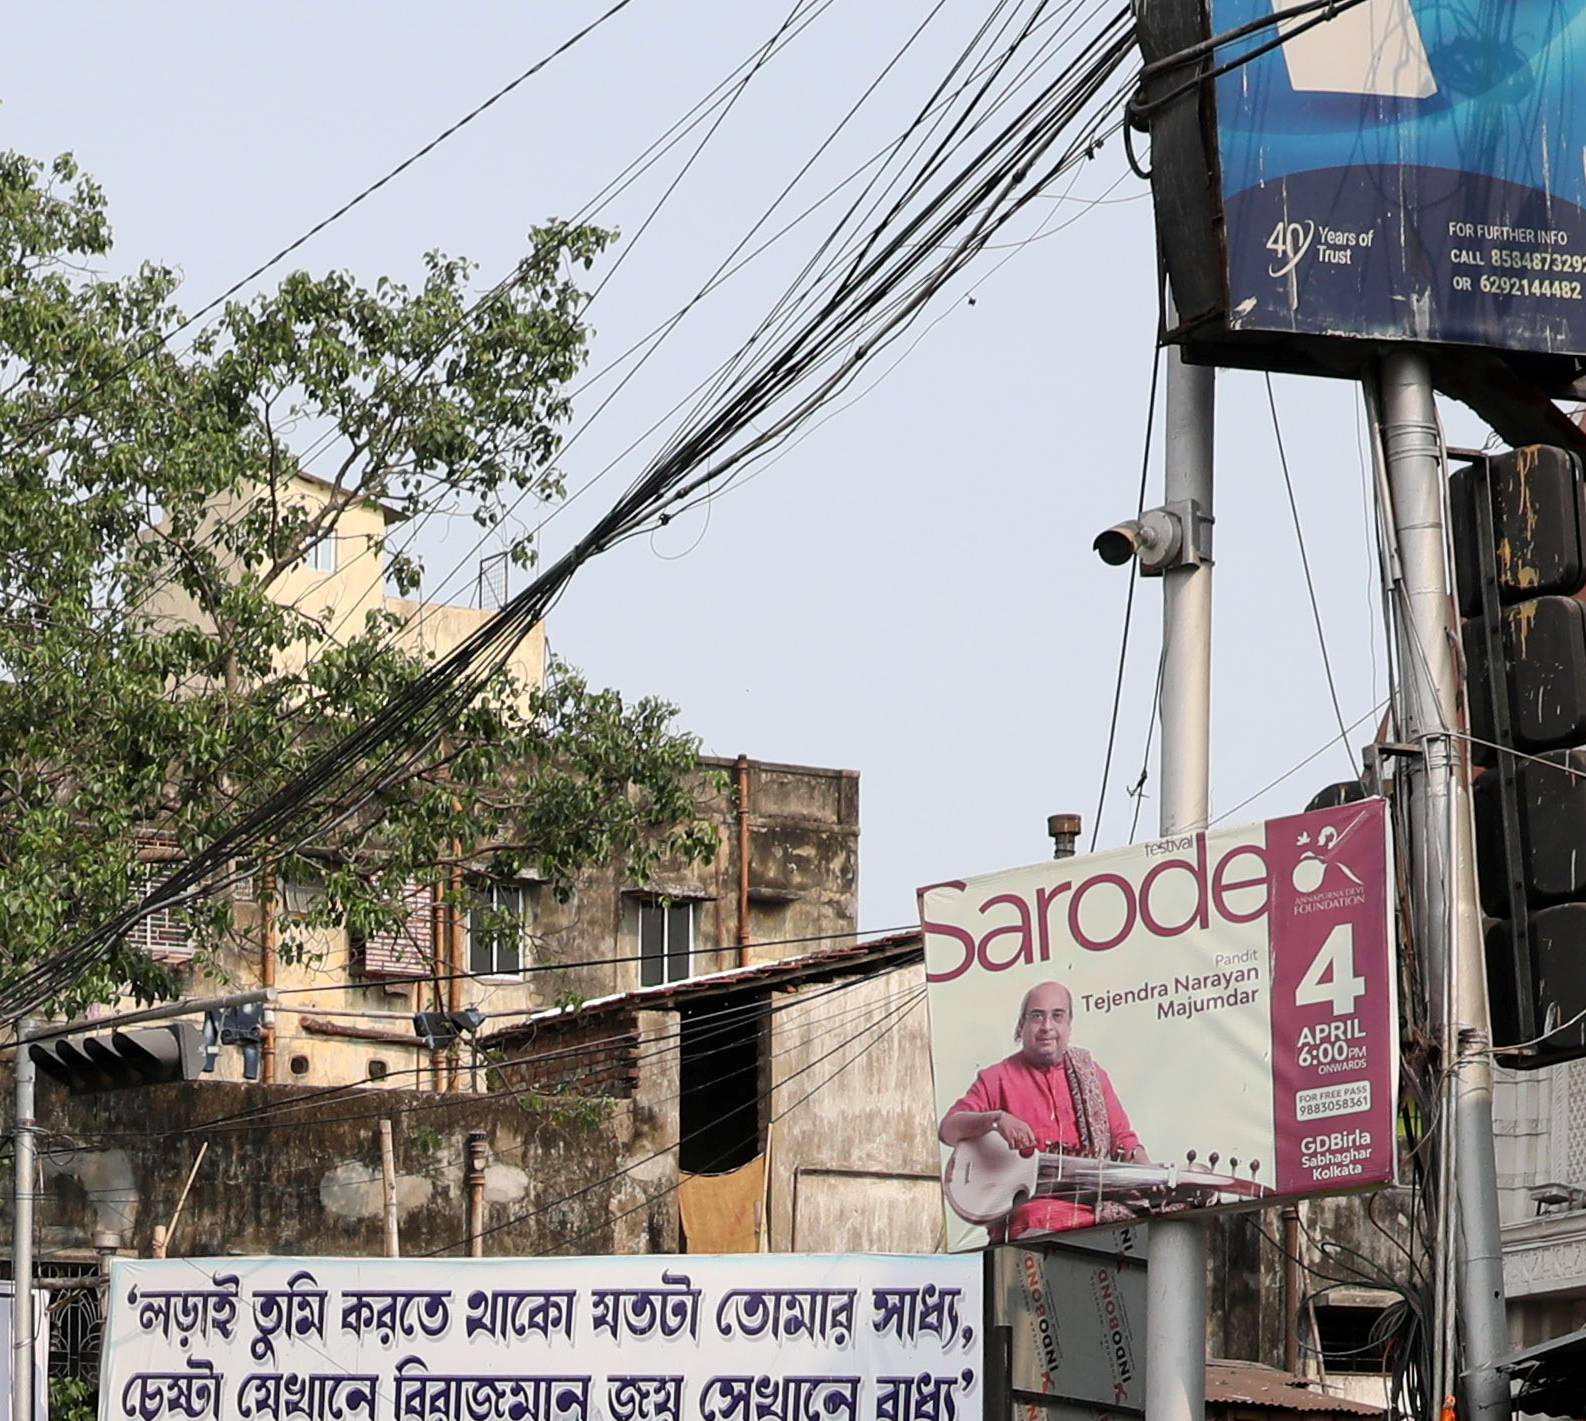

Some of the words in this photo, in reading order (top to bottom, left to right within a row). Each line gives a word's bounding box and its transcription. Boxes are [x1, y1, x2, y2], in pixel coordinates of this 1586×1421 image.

[1318, 226, 1356, 246] Years
[1358, 230, 1375, 247] of
[1449, 222, 1475, 238] FOR
[1478, 224, 1535, 243] FURTHER
[1537, 229, 1568, 246] INFO
[1317, 245, 1352, 265] Trust
[1451, 249, 1484, 267] CALL
[1453, 276, 1472, 291] OR
[1480, 274, 1582, 299] 6292144482
[1144, 834, 1194, 858] festival
[916, 832, 1269, 984] Sarode
[1293, 895, 1365, 916] FOUNDATION
[1215, 949, 1259, 968] Pandit
[1295, 923, 1366, 1017] 4
[1081, 981, 1170, 1015] Tejendra
[1174, 964, 1260, 997] Narayan
[1156, 987, 1260, 1021] Majumdar
[1297, 1019, 1367, 1048] APRIL
[1318, 1059, 1367, 1075] ONWARDS
[1299, 1090, 1317, 1104] FOR
[1320, 1088, 1340, 1100] FREE
[1342, 1084, 1368, 1098] PASS
[1299, 1095, 1368, 1117] 9883058361
[1301, 1129, 1371, 1155] GDBirla
[1301, 1146, 1372, 1169] Sabhaghar
[1312, 1163, 1363, 1181] Kolkata
[251, 1271, 328, 1361] তুমি
[342, 1286, 453, 1348] করতে
[466, 1287, 575, 1343] থাকো
[592, 1271, 702, 1343] যতটা
[717, 1287, 856, 1348] তোমার
